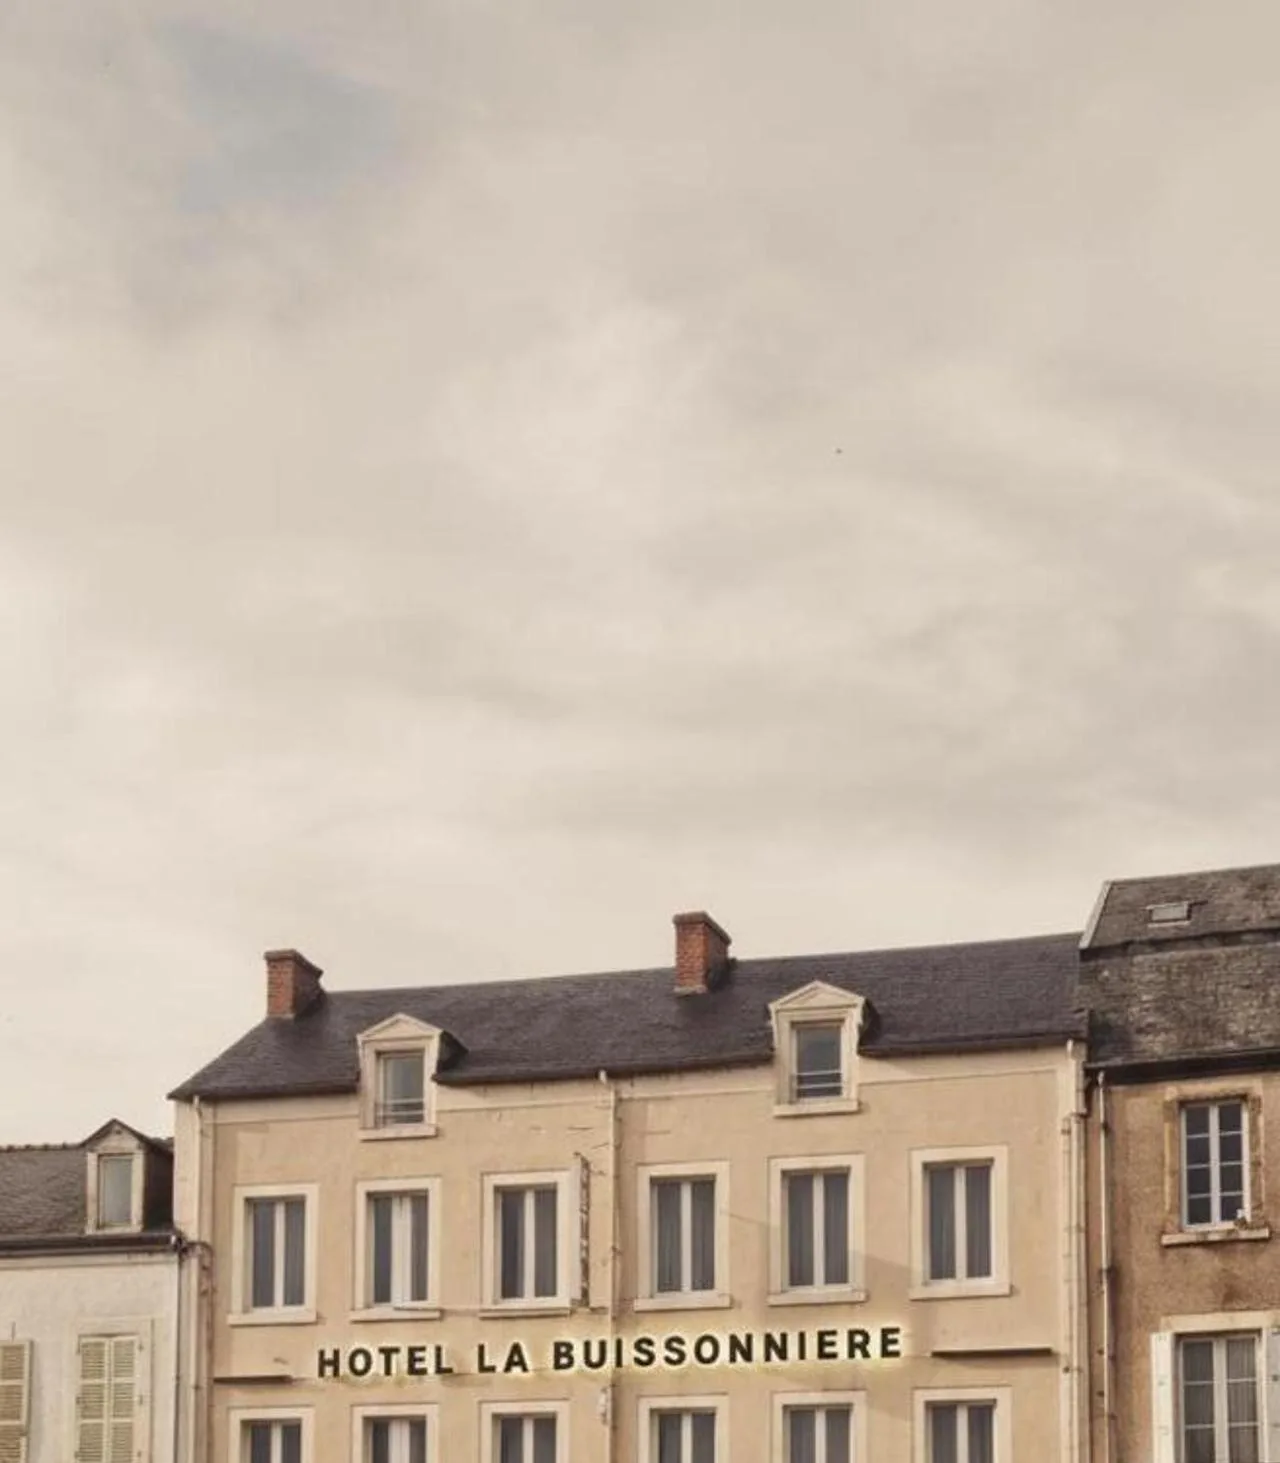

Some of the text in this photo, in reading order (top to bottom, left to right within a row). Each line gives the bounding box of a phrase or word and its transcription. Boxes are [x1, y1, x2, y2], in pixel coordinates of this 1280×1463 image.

[317, 1326, 903, 1379] HOTEL LA BUISSONNIERE
